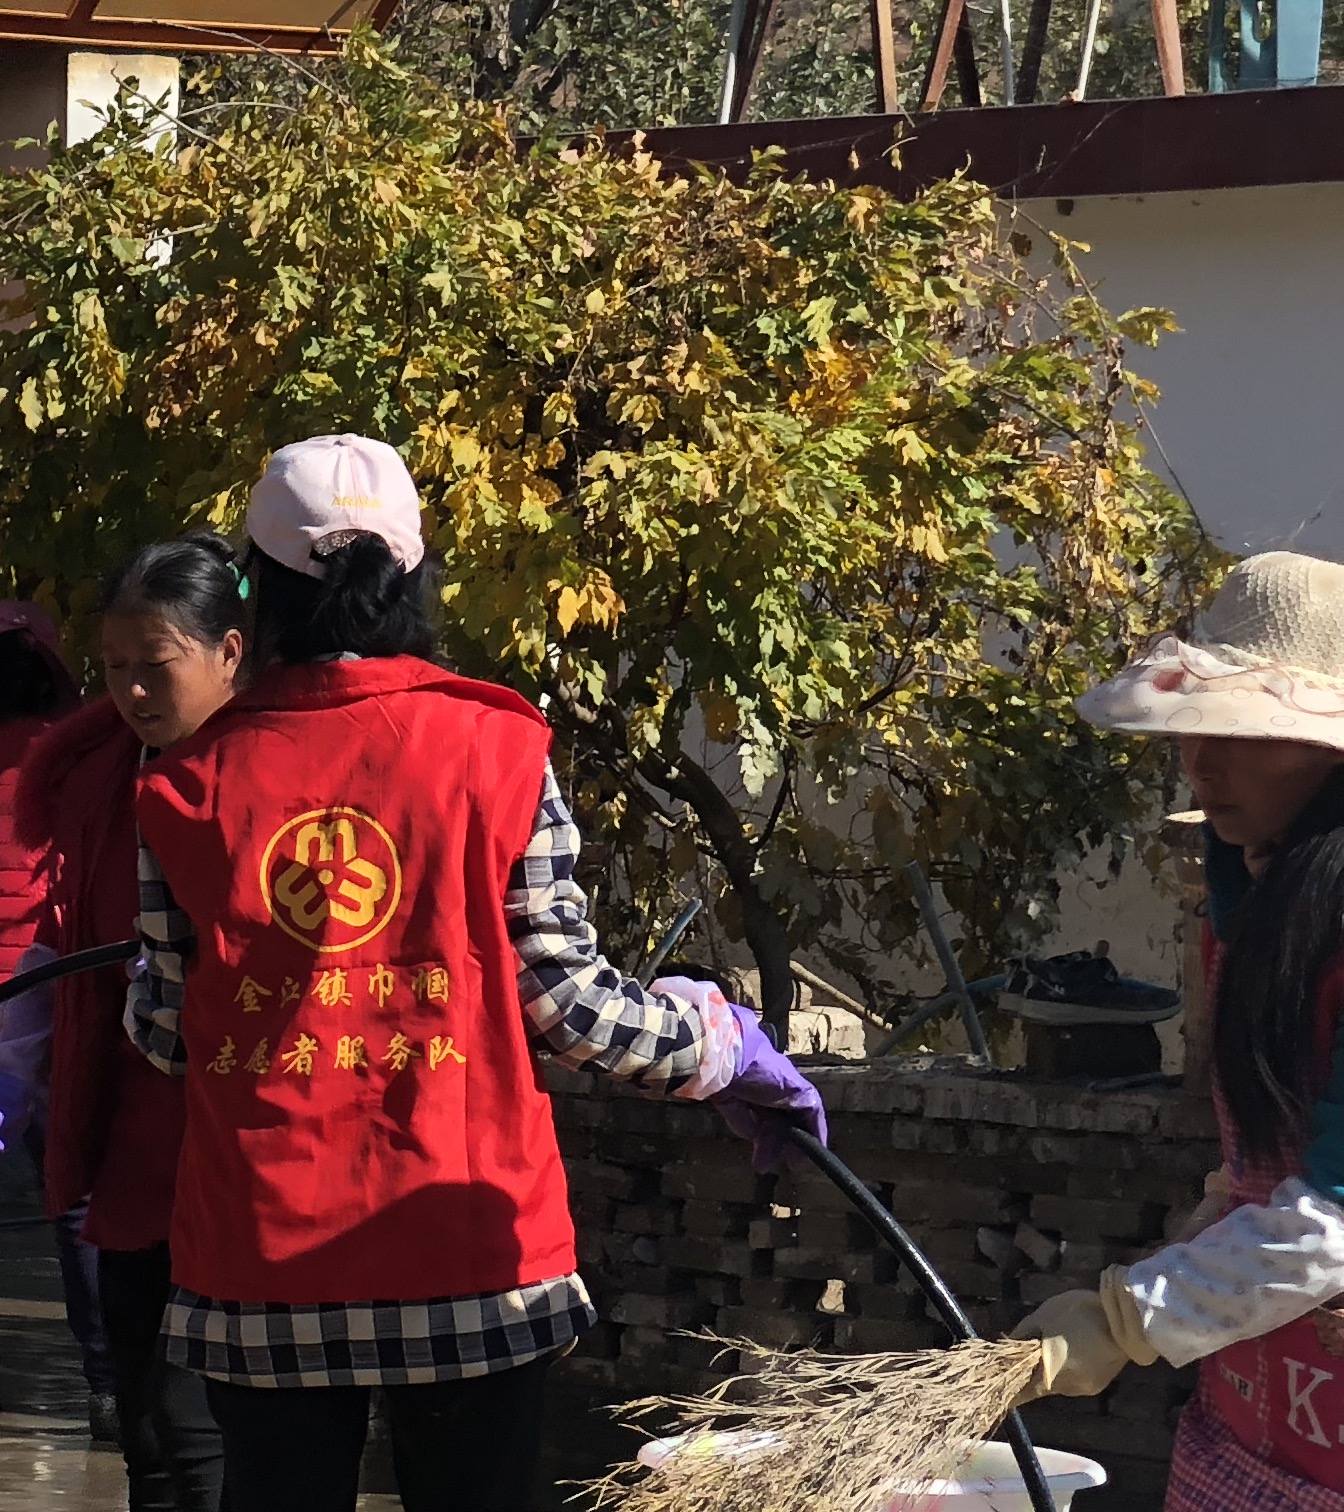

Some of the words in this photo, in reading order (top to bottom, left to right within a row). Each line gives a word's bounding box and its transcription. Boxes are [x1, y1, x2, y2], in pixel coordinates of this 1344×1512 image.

[233, 962, 449, 1013] 金江镇巾帼
[205, 1031, 467, 1076] 志愿者服务队
